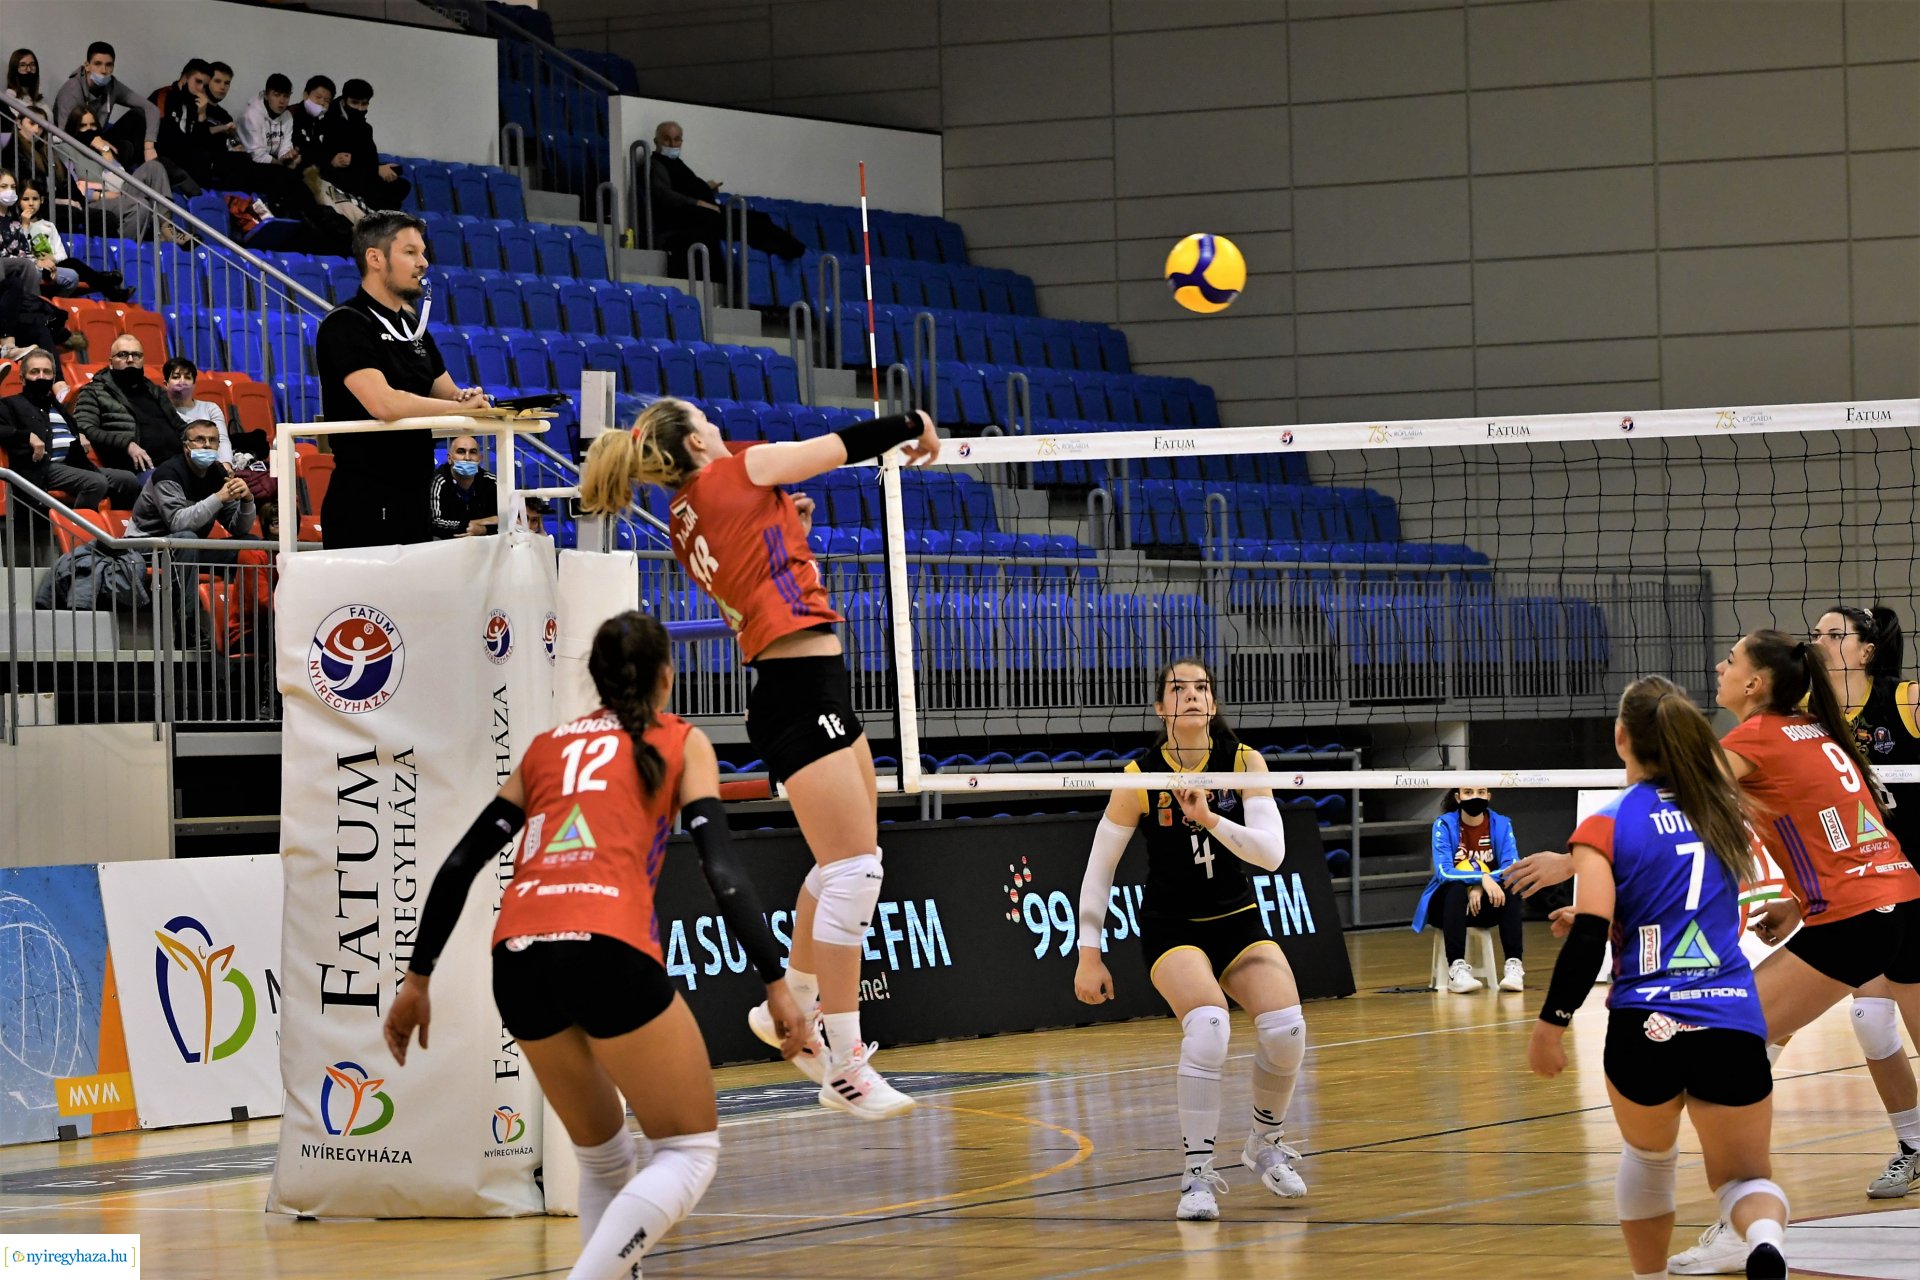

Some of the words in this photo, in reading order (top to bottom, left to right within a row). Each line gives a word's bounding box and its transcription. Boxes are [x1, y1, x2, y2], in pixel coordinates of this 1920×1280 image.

[1846, 407, 1893, 422] FATUM
[1153, 436, 1196, 450] FATUM
[1487, 423, 1531, 438] FATUM
[348, 606, 395, 637] FATUM
[308, 659, 391, 713] NYÍREGYHÁZA
[561, 735, 620, 796] 12
[1395, 774, 1430, 787] FATUM
[1822, 742, 1861, 793] 9
[1062, 777, 1096, 788] FATUM
[1825, 810, 1845, 850] STRABAG
[388, 745, 419, 998] YÍREGYHÁZA
[1190, 834, 1215, 879] 4
[316, 745, 380, 1017] FATUM
[1675, 841, 1706, 911] 7
[1646, 928, 1655, 973] STRABAG
[1670, 987, 1748, 1001] BESTRONG
[69, 1081, 121, 1108] MVM
[301, 1143, 412, 1164] NYÍREGYHÁZA
[484, 1147, 534, 1158] NYÍREGYHÁZA
